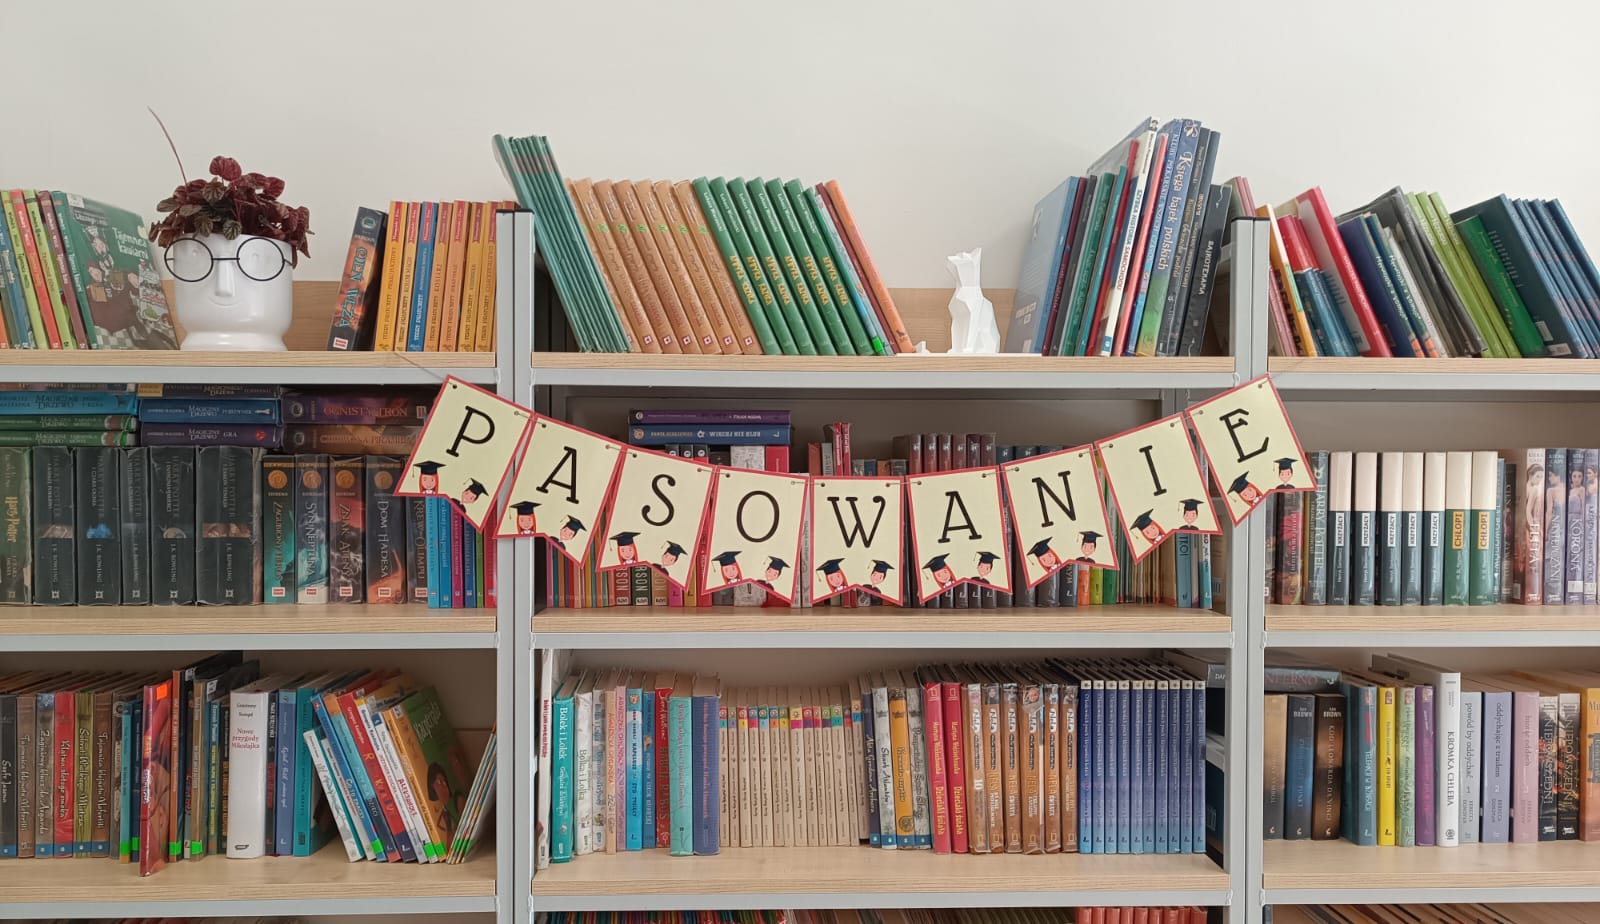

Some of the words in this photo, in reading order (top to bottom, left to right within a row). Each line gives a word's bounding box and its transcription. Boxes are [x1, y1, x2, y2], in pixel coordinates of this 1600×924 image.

[1174, 152, 1193, 192] Księga
[1168, 196, 1182, 224] bajek
[112, 227, 147, 246] Tajemnica
[1158, 227, 1173, 270] polskich
[1199, 240, 1214, 296] BAJKOTERAPIA
[445, 406, 1271, 547] PASOWANIE
[4, 496, 18, 515] Harry
[339, 503, 351, 535] ZNAK
[376, 500, 388, 528] DOM
[1317, 484, 1327, 520] HARRY
[6, 517, 20, 543] Potter
[1315, 526, 1326, 569] POTTER
[1454, 513, 1462, 546] CHŁOPI
[1480, 513, 1488, 547] CHŁOPI
[1529, 522, 1539, 563] ELITA
[1549, 514, 1560, 582] NASTĘPCZYNI
[1571, 518, 1581, 570] KORONA
[306, 526, 318, 576] NEPTUNA
[379, 533, 392, 578] HADESA
[415, 536, 425, 578] OLIMPU
[560, 707, 568, 730] Bolek
[1464, 702, 1473, 728] powód
[1495, 702, 1503, 744] oddychając
[558, 736, 567, 760] Lolek
[1464, 730, 1472, 740] by
[1464, 741, 1473, 779] oddychać
[1544, 719, 1552, 805] NIEPOWSZEDNI
[1564, 718, 1574, 806] NIEPOWSZEDNI
[936, 786, 944, 814] Dzieciaki
[954, 786, 962, 814] Dzieciaki
